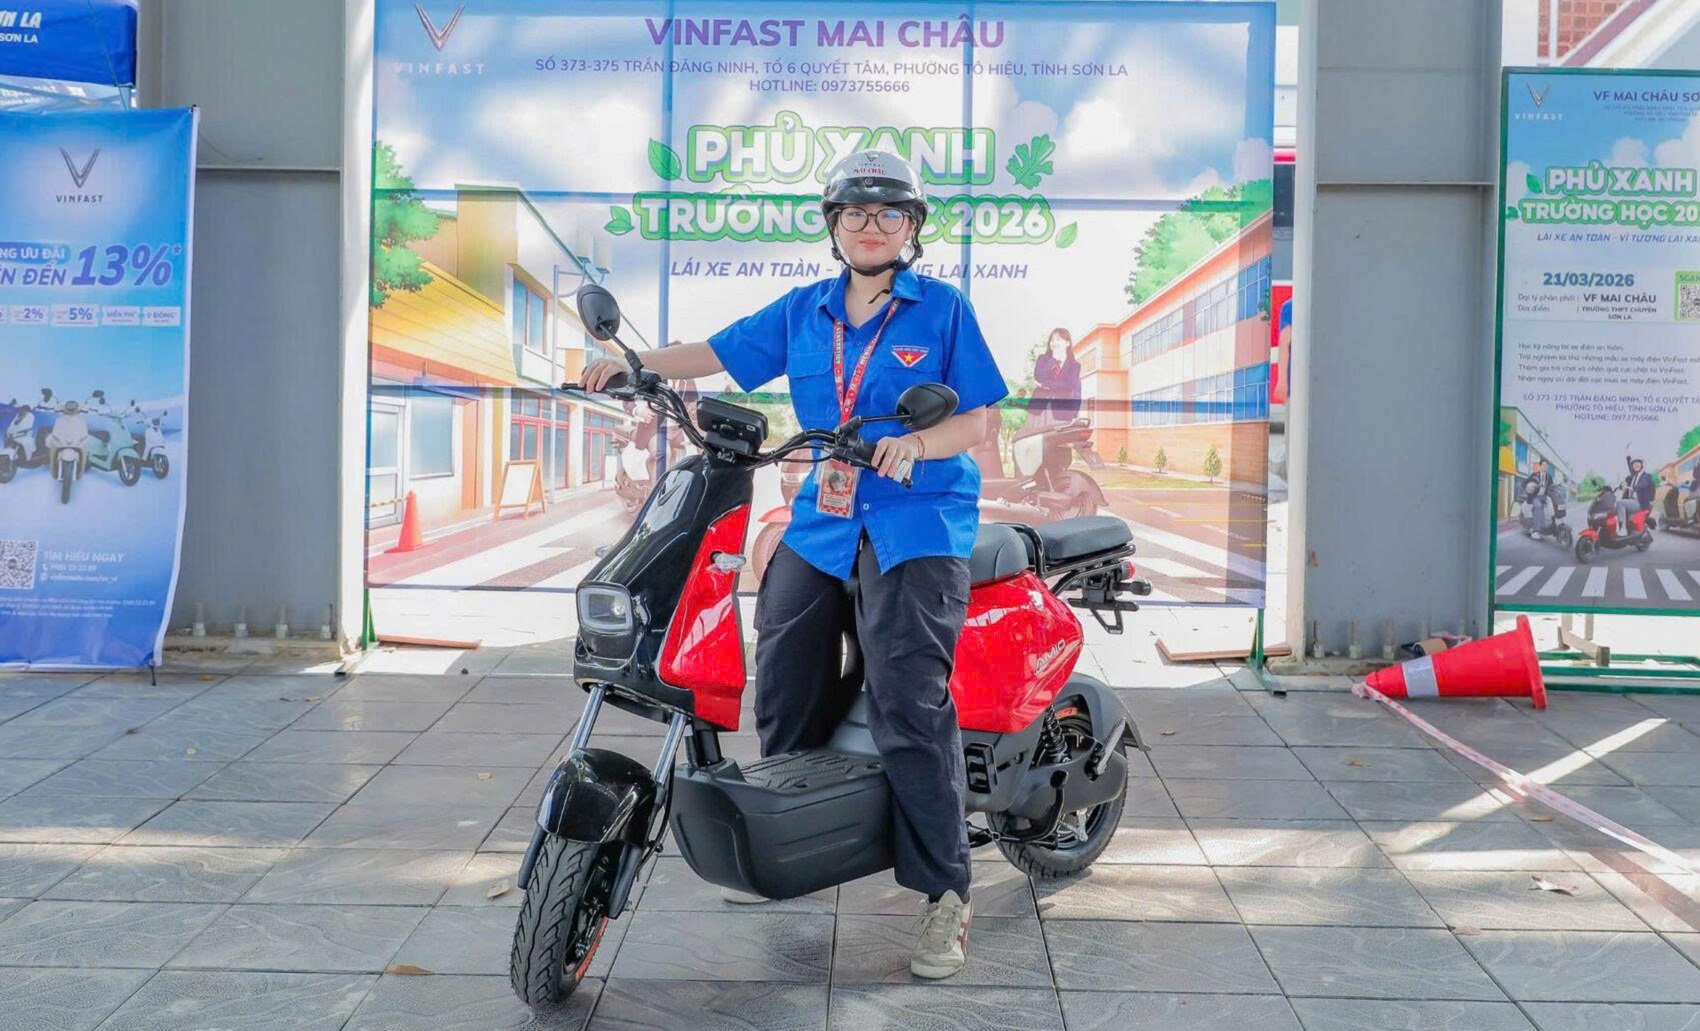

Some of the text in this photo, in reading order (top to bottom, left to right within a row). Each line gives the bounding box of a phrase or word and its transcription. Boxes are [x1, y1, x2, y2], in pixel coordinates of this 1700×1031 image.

[20, 12, 42, 28] LA
[24, 34, 39, 43] LA
[645, 13, 1004, 49] VINFAST MAI CHÂU
[395, 62, 485, 75] VINFAST
[535, 55, 556, 71] SỐ
[561, 59, 620, 72] 373-375
[718, 61, 759, 74] NINH,
[787, 62, 796, 74] 6
[800, 57, 850, 76] QUYẾT
[893, 59, 960, 75] PHƯỜNG
[1072, 62, 1104, 77] SƠN
[1109, 64, 1129, 76] LA
[749, 79, 911, 93] HOTLINE: 0973755666
[1593, 91, 1610, 101] VF
[1613, 92, 1638, 102] MAI
[1641, 88, 1679, 102] CHÂU
[693, 114, 808, 177] PHỦ
[1549, 163, 1694, 193] PHỦ XANH
[56, 195, 103, 203] VINFAST
[640, 189, 828, 236] TRƯỜNG
[949, 201, 1048, 237] 2026
[1522, 199, 1700, 225] TRƯỜNG HỌC 20
[1554, 233, 1567, 241] XE
[1569, 233, 1583, 241] AN
[1668, 234, 1683, 243] LAI
[1686, 235, 1700, 243] XA
[0, 267, 17, 285] N
[22, 261, 67, 286] ĐẾN
[670, 257, 701, 276] LÁI
[706, 262, 731, 277] XE
[736, 262, 765, 277] AN
[770, 257, 821, 278] TOÀN
[938, 264, 969, 279] LAI
[973, 264, 1028, 279] XANH
[1543, 272, 1635, 288] 21/03/2026
[1583, 292, 1657, 304] VF MAI CHÂU
[1668, 405, 1678, 413] LA
